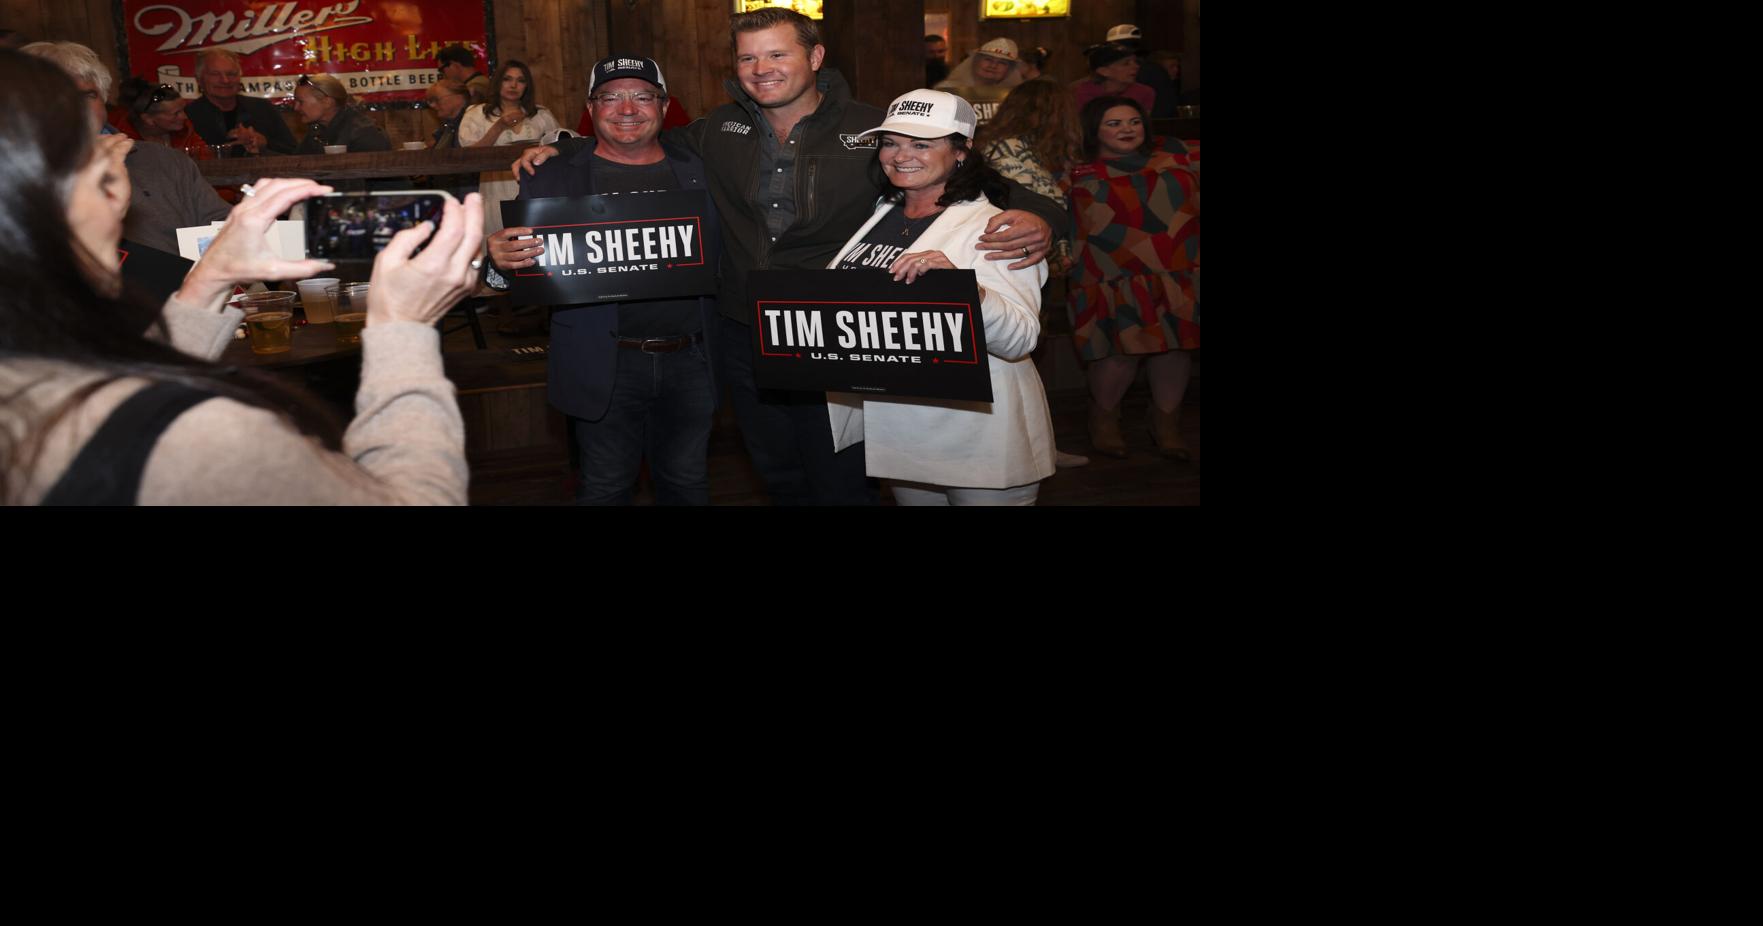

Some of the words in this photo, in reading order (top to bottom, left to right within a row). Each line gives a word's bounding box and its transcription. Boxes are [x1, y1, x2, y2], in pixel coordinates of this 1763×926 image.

[304, 36, 395, 64] HIGH
[350, 75, 401, 88] BOTTLE
[899, 100, 934, 113] SHEEHY
[585, 225, 694, 264] SHEEHY
[561, 268, 592, 276] U.S.
[597, 263, 658, 274] SENATE
[764, 309, 825, 348] TIM
[835, 310, 964, 353] SHEEHY
[810, 352, 844, 361] U.S.
[849, 354, 922, 364] SENATE
